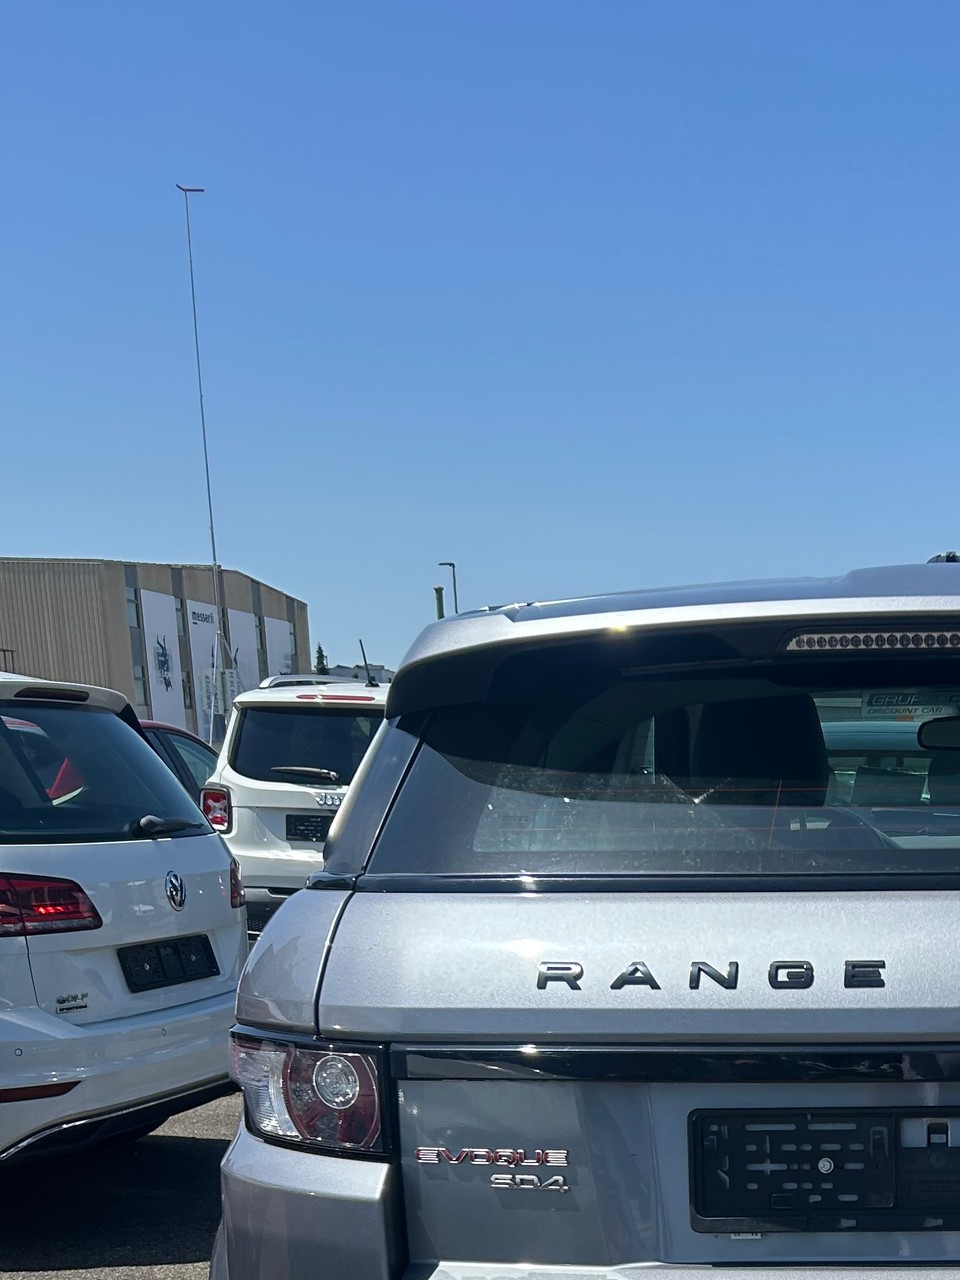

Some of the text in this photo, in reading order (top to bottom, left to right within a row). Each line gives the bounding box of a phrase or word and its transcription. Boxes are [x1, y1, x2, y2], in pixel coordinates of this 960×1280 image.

[315, 792, 343, 805] Jee
[536, 959, 887, 991] RANGE
[415, 1146, 569, 1168] EVOQUE
[490, 1173, 572, 1192] SD4
